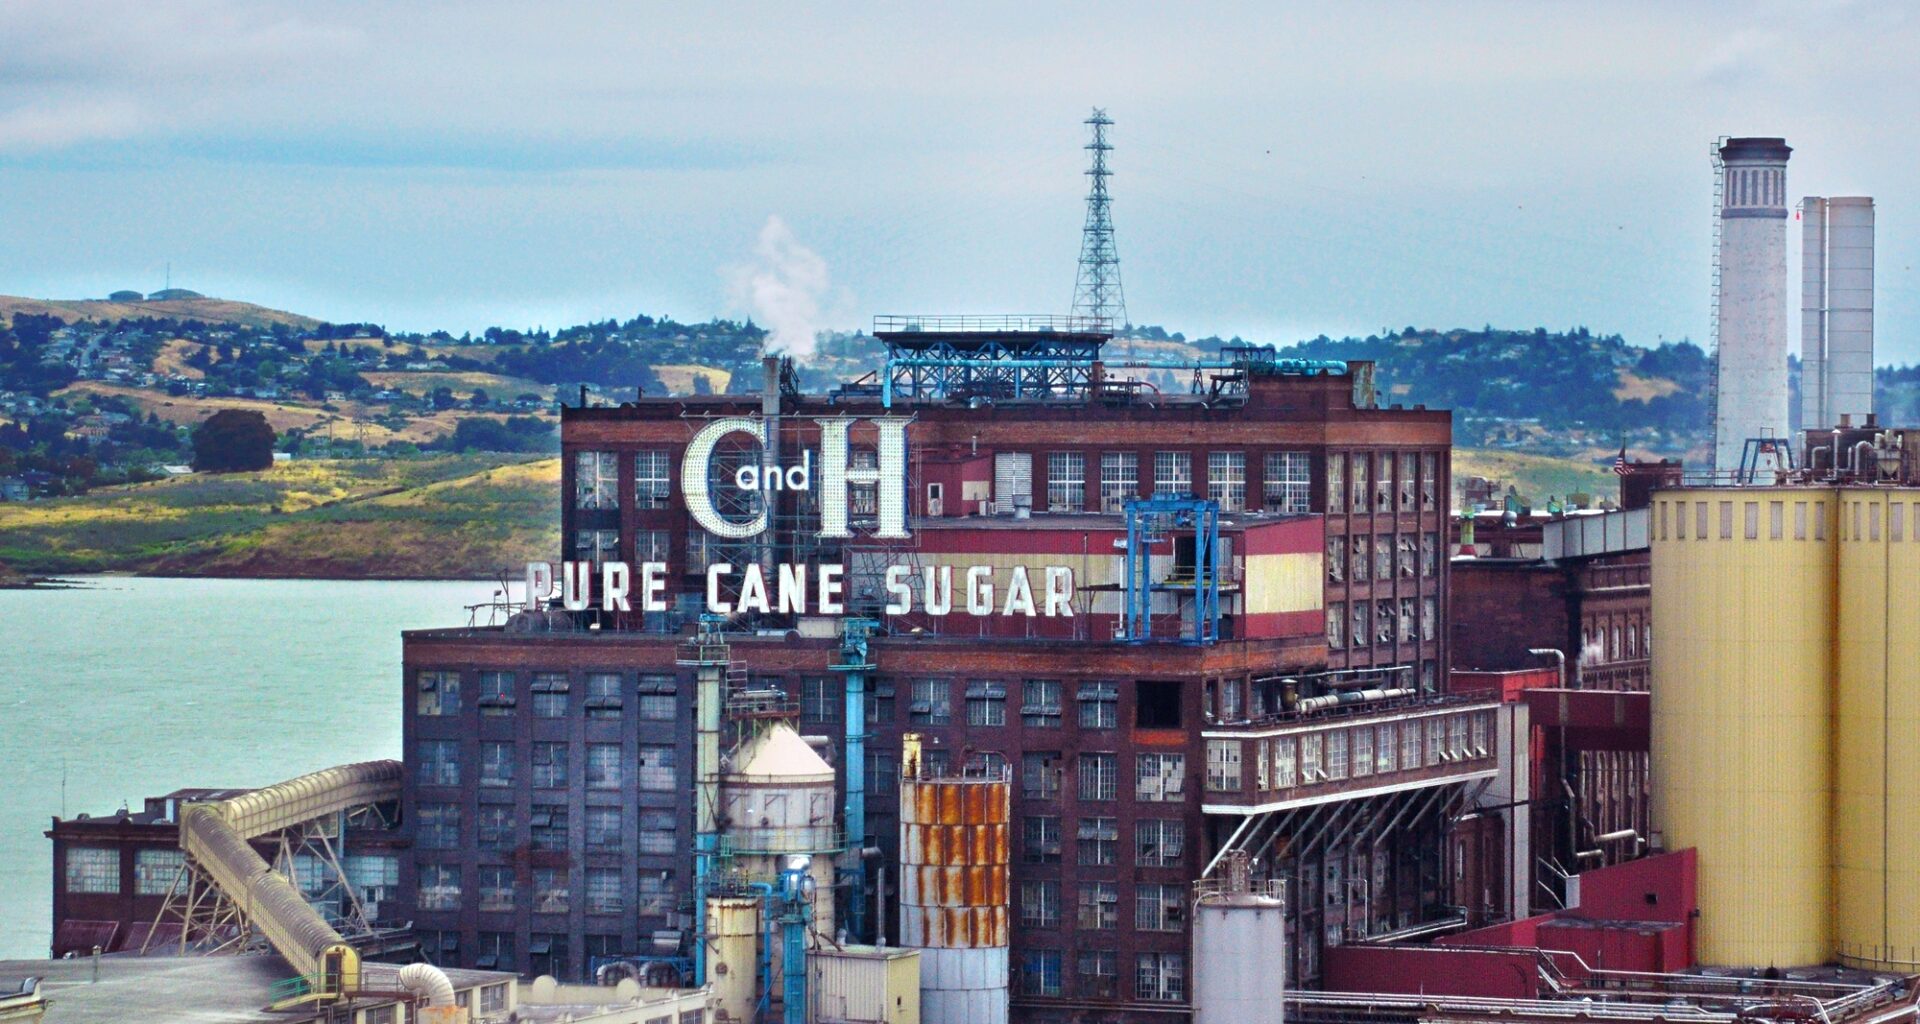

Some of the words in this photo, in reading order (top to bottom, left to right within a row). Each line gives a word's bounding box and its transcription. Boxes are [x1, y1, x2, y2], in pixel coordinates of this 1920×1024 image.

[681, 417, 769, 538] C
[735, 449, 811, 491] and
[813, 418, 917, 538] H
[525, 561, 668, 612] PURE
[707, 563, 845, 614] CANE
[886, 565, 1075, 617] SUGAR
